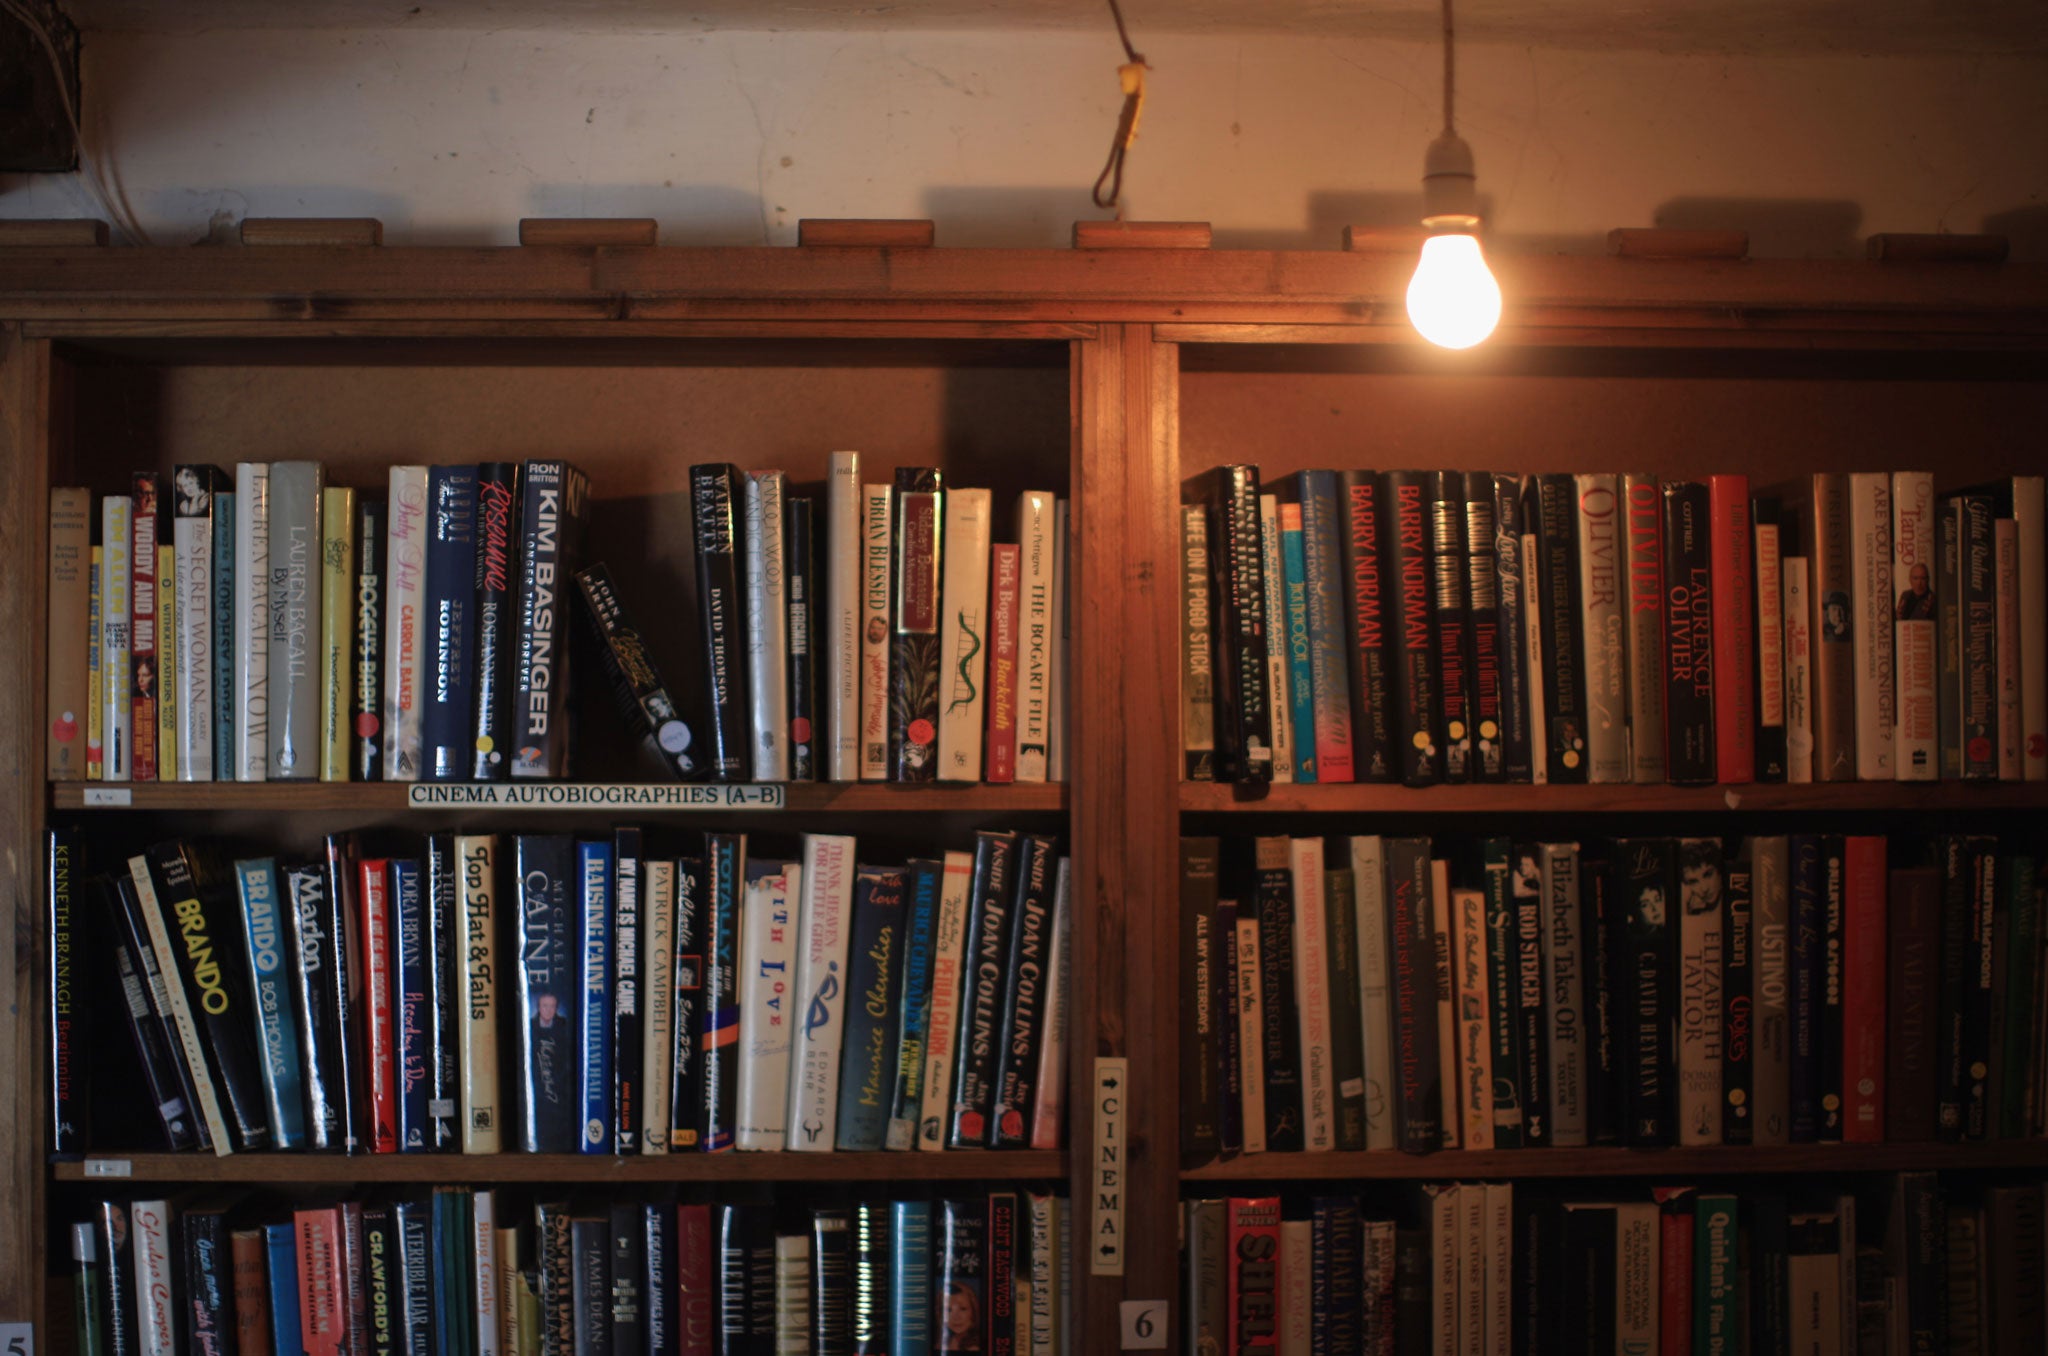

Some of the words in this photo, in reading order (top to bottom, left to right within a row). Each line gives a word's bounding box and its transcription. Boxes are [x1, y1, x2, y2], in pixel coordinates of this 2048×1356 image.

[529, 464, 559, 475] RON
[111, 505, 125, 543] TIM
[194, 523, 206, 542] The
[251, 474, 268, 564] LAUREN
[449, 475, 471, 544] BARDOT
[478, 480, 513, 592] Roseanne
[535, 488, 558, 552] KIM
[700, 475, 716, 553] BEATTY
[714, 473, 732, 554] WARREN
[869, 496, 888, 541] BRIAN
[1349, 485, 1377, 552] BARRY
[1398, 485, 1424, 552] BARRY
[1682, 501, 1694, 553] COTTRELL
[1829, 489, 1843, 584] PRIESTLEY
[1896, 504, 1921, 566] Tango
[134, 516, 153, 577] WOODY
[271, 567, 288, 586] By
[289, 526, 306, 604] LAUREN
[998, 551, 1014, 586] Dirk
[1580, 488, 1618, 610] OLIVIER
[1628, 483, 1661, 614] OLIVIER
[111, 550, 125, 615] ALLEN
[135, 580, 153, 614] AND
[191, 546, 206, 613] SECRET
[583, 575, 615, 631] PARKER
[596, 578, 621, 617] JOHN
[867, 545, 888, 610] BLESSED
[1030, 582, 1045, 618] THE
[1353, 556, 1383, 649] NORMAN
[1401, 556, 1428, 649] NORMAN
[134, 620, 153, 652] MIA
[162, 603, 172, 650] WITHOUT
[250, 575, 267, 663] BACALL
[271, 590, 288, 643] Myself
[400, 605, 413, 662] CARROLL
[710, 588, 723, 631] DAVID
[994, 589, 1013, 655] Bogarde
[1669, 585, 1693, 682] OLIVIER
[1691, 567, 1711, 698] LAURENCE
[191, 623, 206, 703] WOMAN
[288, 608, 306, 682] BACALL
[436, 599, 450, 703] ROBINSON
[450, 600, 462, 687] JEFFREY
[527, 561, 554, 736] BASINGER
[712, 635, 727, 705] THOMSON
[1028, 623, 1044, 694] BOGART
[1368, 652, 1382, 677] and
[162, 652, 172, 702] FEATHERS
[399, 667, 412, 711] BAKER
[994, 658, 1012, 731] Backcloth
[1367, 680, 1384, 708] why
[248, 674, 267, 742] NOW
[1027, 699, 1043, 738] FILE
[1372, 711, 1387, 742] not?
[411, 786, 498, 802] CINEMA
[505, 786, 718, 803] AUTOBIOGRAPHIES
[55, 845, 70, 928] KENNETH
[401, 872, 420, 914] DORA
[467, 847, 490, 887] Top
[619, 857, 636, 876] MY
[619, 878, 636, 911] NAME
[826, 844, 842, 889] THANK
[988, 839, 1009, 892] INSIDE
[1029, 839, 1050, 892] INSIDE
[1729, 872, 1750, 894] Liv
[245, 869, 280, 972] BRANDO
[300, 873, 325, 974] Marlon
[467, 892, 490, 941] Hat
[525, 870, 549, 985] CAINE
[552, 879, 565, 976] MICHAEL
[586, 858, 604, 938] RAISING
[618, 913, 636, 925] IS
[654, 866, 669, 940] PATRICK
[719, 841, 735, 963] TOTALLY
[825, 894, 840, 949] HEAVEN
[912, 872, 935, 942] MAURICE
[1196, 914, 1208, 937] ALL
[1302, 852, 1317, 942] REMEMBERING
[1518, 905, 1536, 940] ROD
[1551, 855, 1574, 947] Elizabeth
[173, 898, 230, 1016] BRANDO
[403, 917, 420, 968] BRYAN
[470, 946, 488, 964] &
[618, 927, 637, 979] MICHAEL
[979, 898, 1005, 958] JOAN
[1021, 898, 1046, 958] JOAN
[1196, 938, 1209, 957] MY
[1277, 899, 1291, 972] ARNOLD
[1729, 899, 1750, 968] Ullmann
[56, 932, 71, 1015] BRANAGH
[260, 980, 278, 1011] BOB
[469, 964, 492, 1020] Tails
[587, 941, 605, 995] CAINE
[653, 948, 667, 1037] CAMPBELL
[865, 925, 893, 1018] Chevalier
[903, 945, 929, 1033] CHEVALIER
[933, 957, 956, 1008] PETULA
[1262, 899, 1281, 1061] SCHWARZENEGGER
[1304, 945, 1319, 985] PETER
[1519, 942, 1540, 1008] STEIGER
[1554, 950, 1575, 1004] Takes
[1704, 931, 1720, 1060] ELIZABETH
[1760, 924, 1786, 1010] USTINOV
[617, 980, 635, 1016] CAINE
[971, 961, 1001, 1056] COLLINS
[1012, 961, 1041, 1056] COLLINS
[1196, 958, 1209, 1034] YESTERDAYS
[1307, 987, 1322, 1041] SELLERS
[1555, 1008, 1577, 1044] Off
[1684, 952, 1704, 1044] TAYLOR
[265, 1012, 286, 1076] THOMAS
[588, 1000, 603, 1064] WILLIAM
[928, 1010, 950, 1056] CLARK
[1727, 995, 1752, 1063] Choices
[57, 1020, 72, 1101] Beginning
[588, 1066, 603, 1102] HALL
[805, 1050, 816, 1091] BEHR
[815, 1050, 828, 1117] EDWARD
[859, 1026, 885, 1108] Maurice
[1557, 1063, 1567, 1106] TAYLOR
[1567, 1052, 1579, 1116] ELIZABETH
[976, 1079, 988, 1104] Jay
[1016, 1079, 1029, 1104] Jay
[1099, 1099, 1118, 1235] CINEMA
[406, 1222, 424, 1231] A
[477, 1222, 493, 1258] Bing
[902, 1214, 927, 1254] FAYE
[996, 1207, 1011, 1247] CLINT
[1032, 1209, 1048, 1251] DICK
[1313, 1207, 1327, 1307] TRAVELLING
[1708, 1211, 1733, 1298] Quinlan's
[134, 1208, 164, 1278] Gladys
[150, 1283, 172, 1348] Cooper
[368, 1230, 390, 1343] CRAWFORD'S
[406, 1233, 427, 1293] TERRIBLE
[478, 1262, 496, 1317] Crosby
[588, 1250, 604, 1297] JAMES
[725, 1249, 745, 1334] DIETRICH
[751, 1249, 774, 1335] MARLENE
[995, 1250, 1011, 1318] EASTWOOD
[1032, 1258, 1049, 1316] EMERY
[409, 1296, 429, 1325] LIAR
[589, 1301, 604, 1342] DEAN
[902, 1264, 927, 1341] DUNAWAY
[1135, 1309, 1153, 1338] 6
[1709, 1303, 1725, 1334] Film
[8, 1337, 25, 1356] 5
[1033, 1327, 1049, 1345] IN
